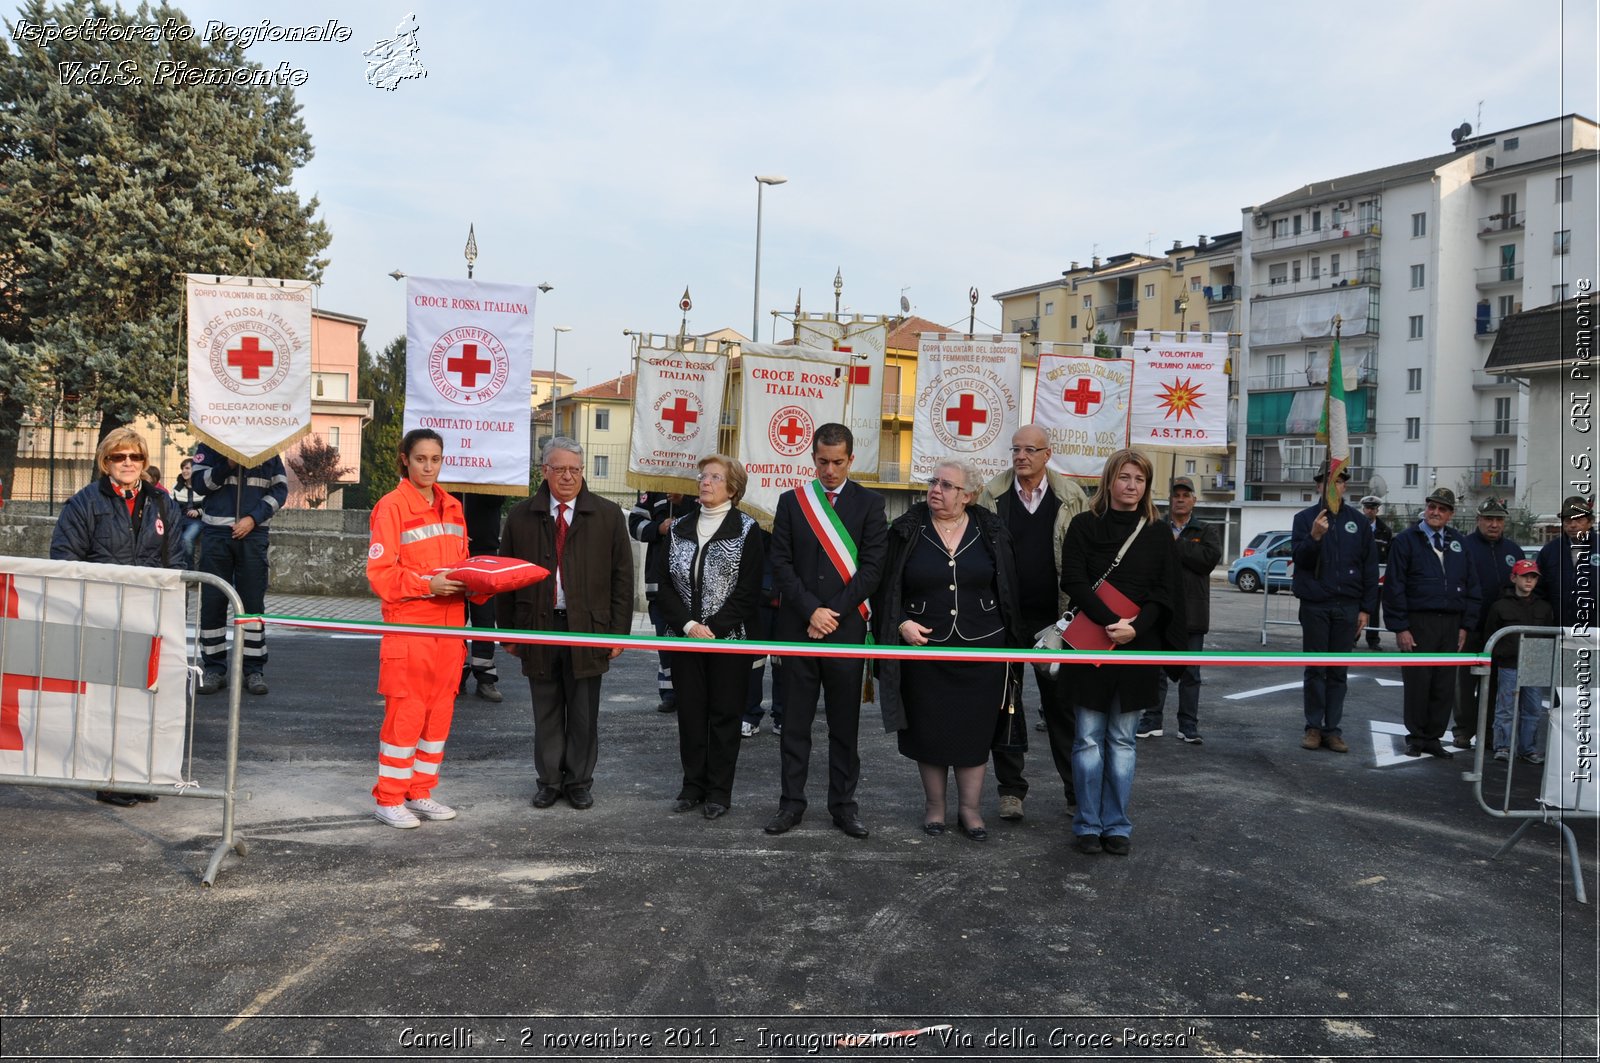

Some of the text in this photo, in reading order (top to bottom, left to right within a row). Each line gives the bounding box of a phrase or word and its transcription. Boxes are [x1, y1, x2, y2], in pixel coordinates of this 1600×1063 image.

[195, 289, 304, 302] CORPO VOLONTARI DEL SOCCORSO
[414, 296, 528, 314] CROCE ROSSA ITALIANA
[197, 306, 302, 351] CROCE ROSSA ITALIANA
[943, 344, 974, 352] VOLONTARI
[212, 322, 290, 392] CONVENZIONE DI GINEVRA 22 AGOSTO 1864
[430, 328, 508, 401] CONVENZIONE DI GINEVRA 22 AGOSTO 1864
[649, 358, 716, 372] CROCE ROSSA
[1148, 362, 1184, 370] "PULMINO
[660, 370, 704, 382] ITALIANA
[752, 368, 839, 388] CROCE ROSSA
[766, 384, 824, 399] ITALIANA
[918, 364, 1016, 411] CROCE ROSSA ITALIANA
[944, 386, 952, 396] DI
[954, 380, 990, 396] GINEVRA
[208, 403, 292, 412] DELEGAZIONE DI
[654, 392, 672, 410] CORPO
[201, 415, 299, 426] PIOVA' MASSAIA
[420, 416, 514, 432] COMITATO LOCALE
[932, 396, 957, 448] CONVENZIONE
[990, 407, 1000, 437] AGOSTO
[655, 422, 666, 436] DEL
[1151, 430, 1208, 439] A.S.T.R.O.
[461, 438, 471, 448] DI
[1095, 432, 1117, 445] V.D.S.
[653, 450, 686, 458] GRUPPO
[969, 458, 997, 466] OCALE
[746, 464, 818, 478] COMITATO LOCA
[761, 478, 770, 487] DI
